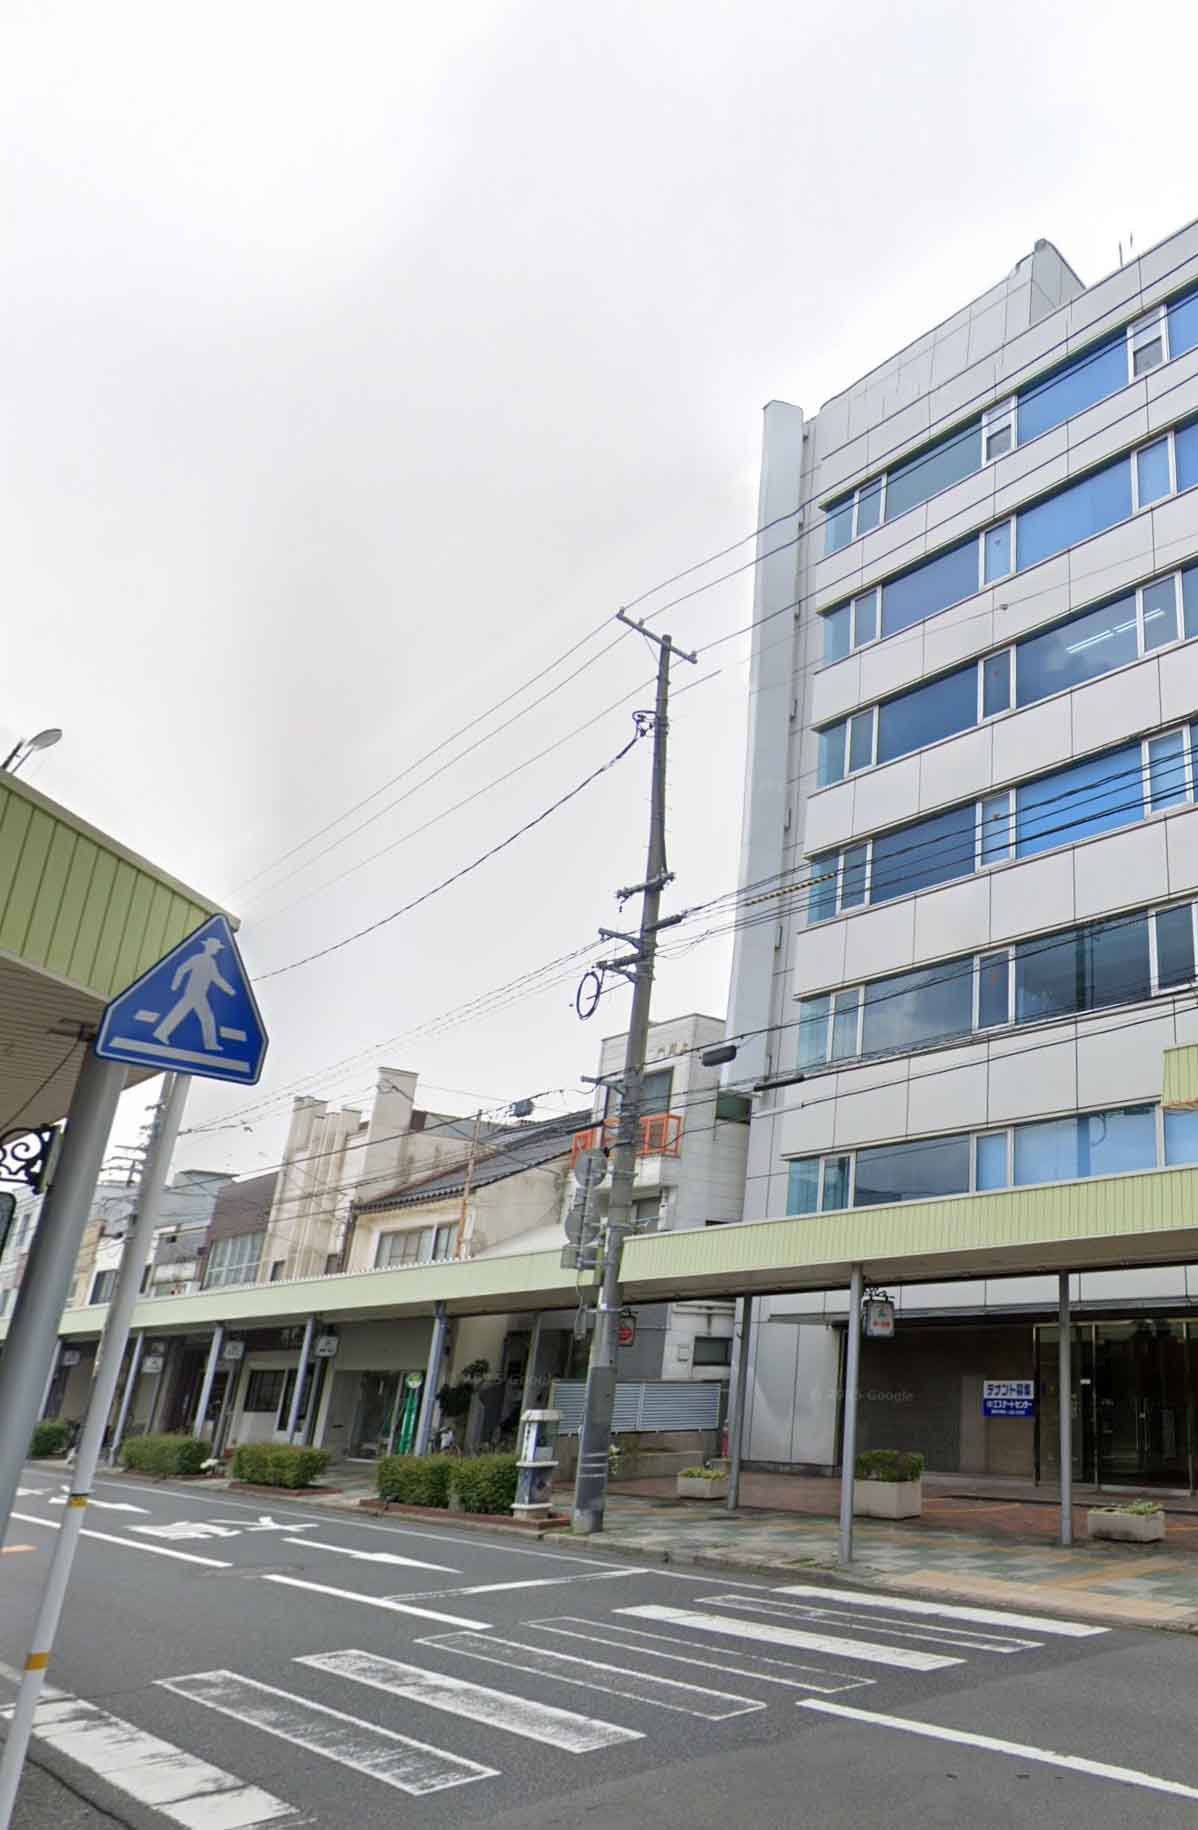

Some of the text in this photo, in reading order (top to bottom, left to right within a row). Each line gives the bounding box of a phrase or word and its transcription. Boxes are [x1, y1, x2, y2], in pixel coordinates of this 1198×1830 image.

[986, 1383, 1031, 1396] テナント募集
